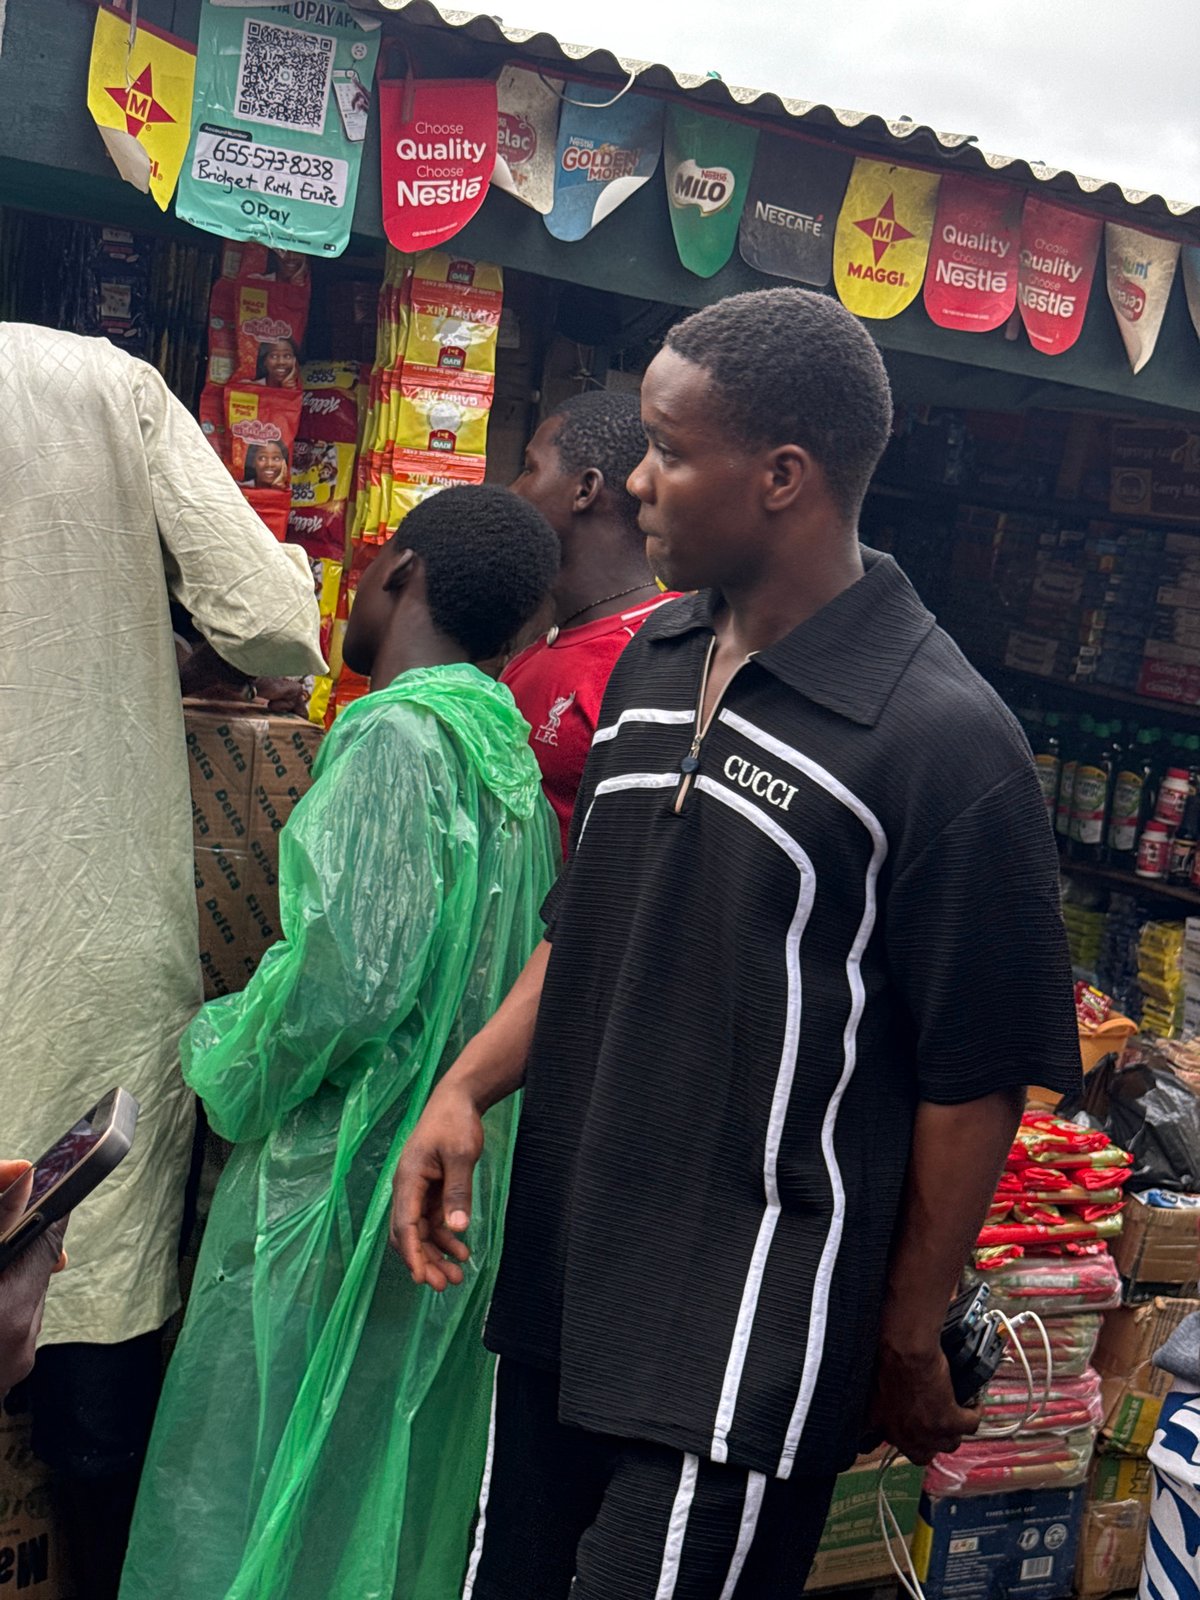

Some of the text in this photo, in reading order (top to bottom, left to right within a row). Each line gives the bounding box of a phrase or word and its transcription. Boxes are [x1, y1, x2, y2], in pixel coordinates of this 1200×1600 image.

[294, 2, 336, 27] OPAY
[129, 93, 148, 117] M
[415, 121, 464, 135] Choose
[498, 129, 531, 150] elac
[213, 139, 333, 180] 655-573-8238
[396, 138, 487, 163] Quality
[562, 146, 641, 172] GOLDEN
[198, 160, 258, 194] Bridget
[264, 176, 293, 197] Ruth
[416, 165, 464, 178] Choose
[587, 166, 635, 182] MORN
[397, 175, 483, 207] Nestlé
[674, 173, 727, 202] MILO
[241, 200, 291, 225] OPay
[755, 200, 825, 237] NESCAFÉ
[875, 220, 893, 240] M
[942, 225, 1011, 259] Quality
[1035, 238, 1069, 256] Choose
[847, 261, 906, 287] MAGGI
[1019, 250, 1083, 283] Quality
[1028, 273, 1061, 291] Choose
[187, 732, 215, 781] Delta
[217, 724, 247, 773] Delta
[723, 754, 799, 812] CUCCI
[215, 789, 246, 837] Delta
[211, 844, 242, 891] Delta
[252, 841, 277, 886] Delta
[206, 897, 236, 945] Delta
[246, 893, 274, 938] Delta
